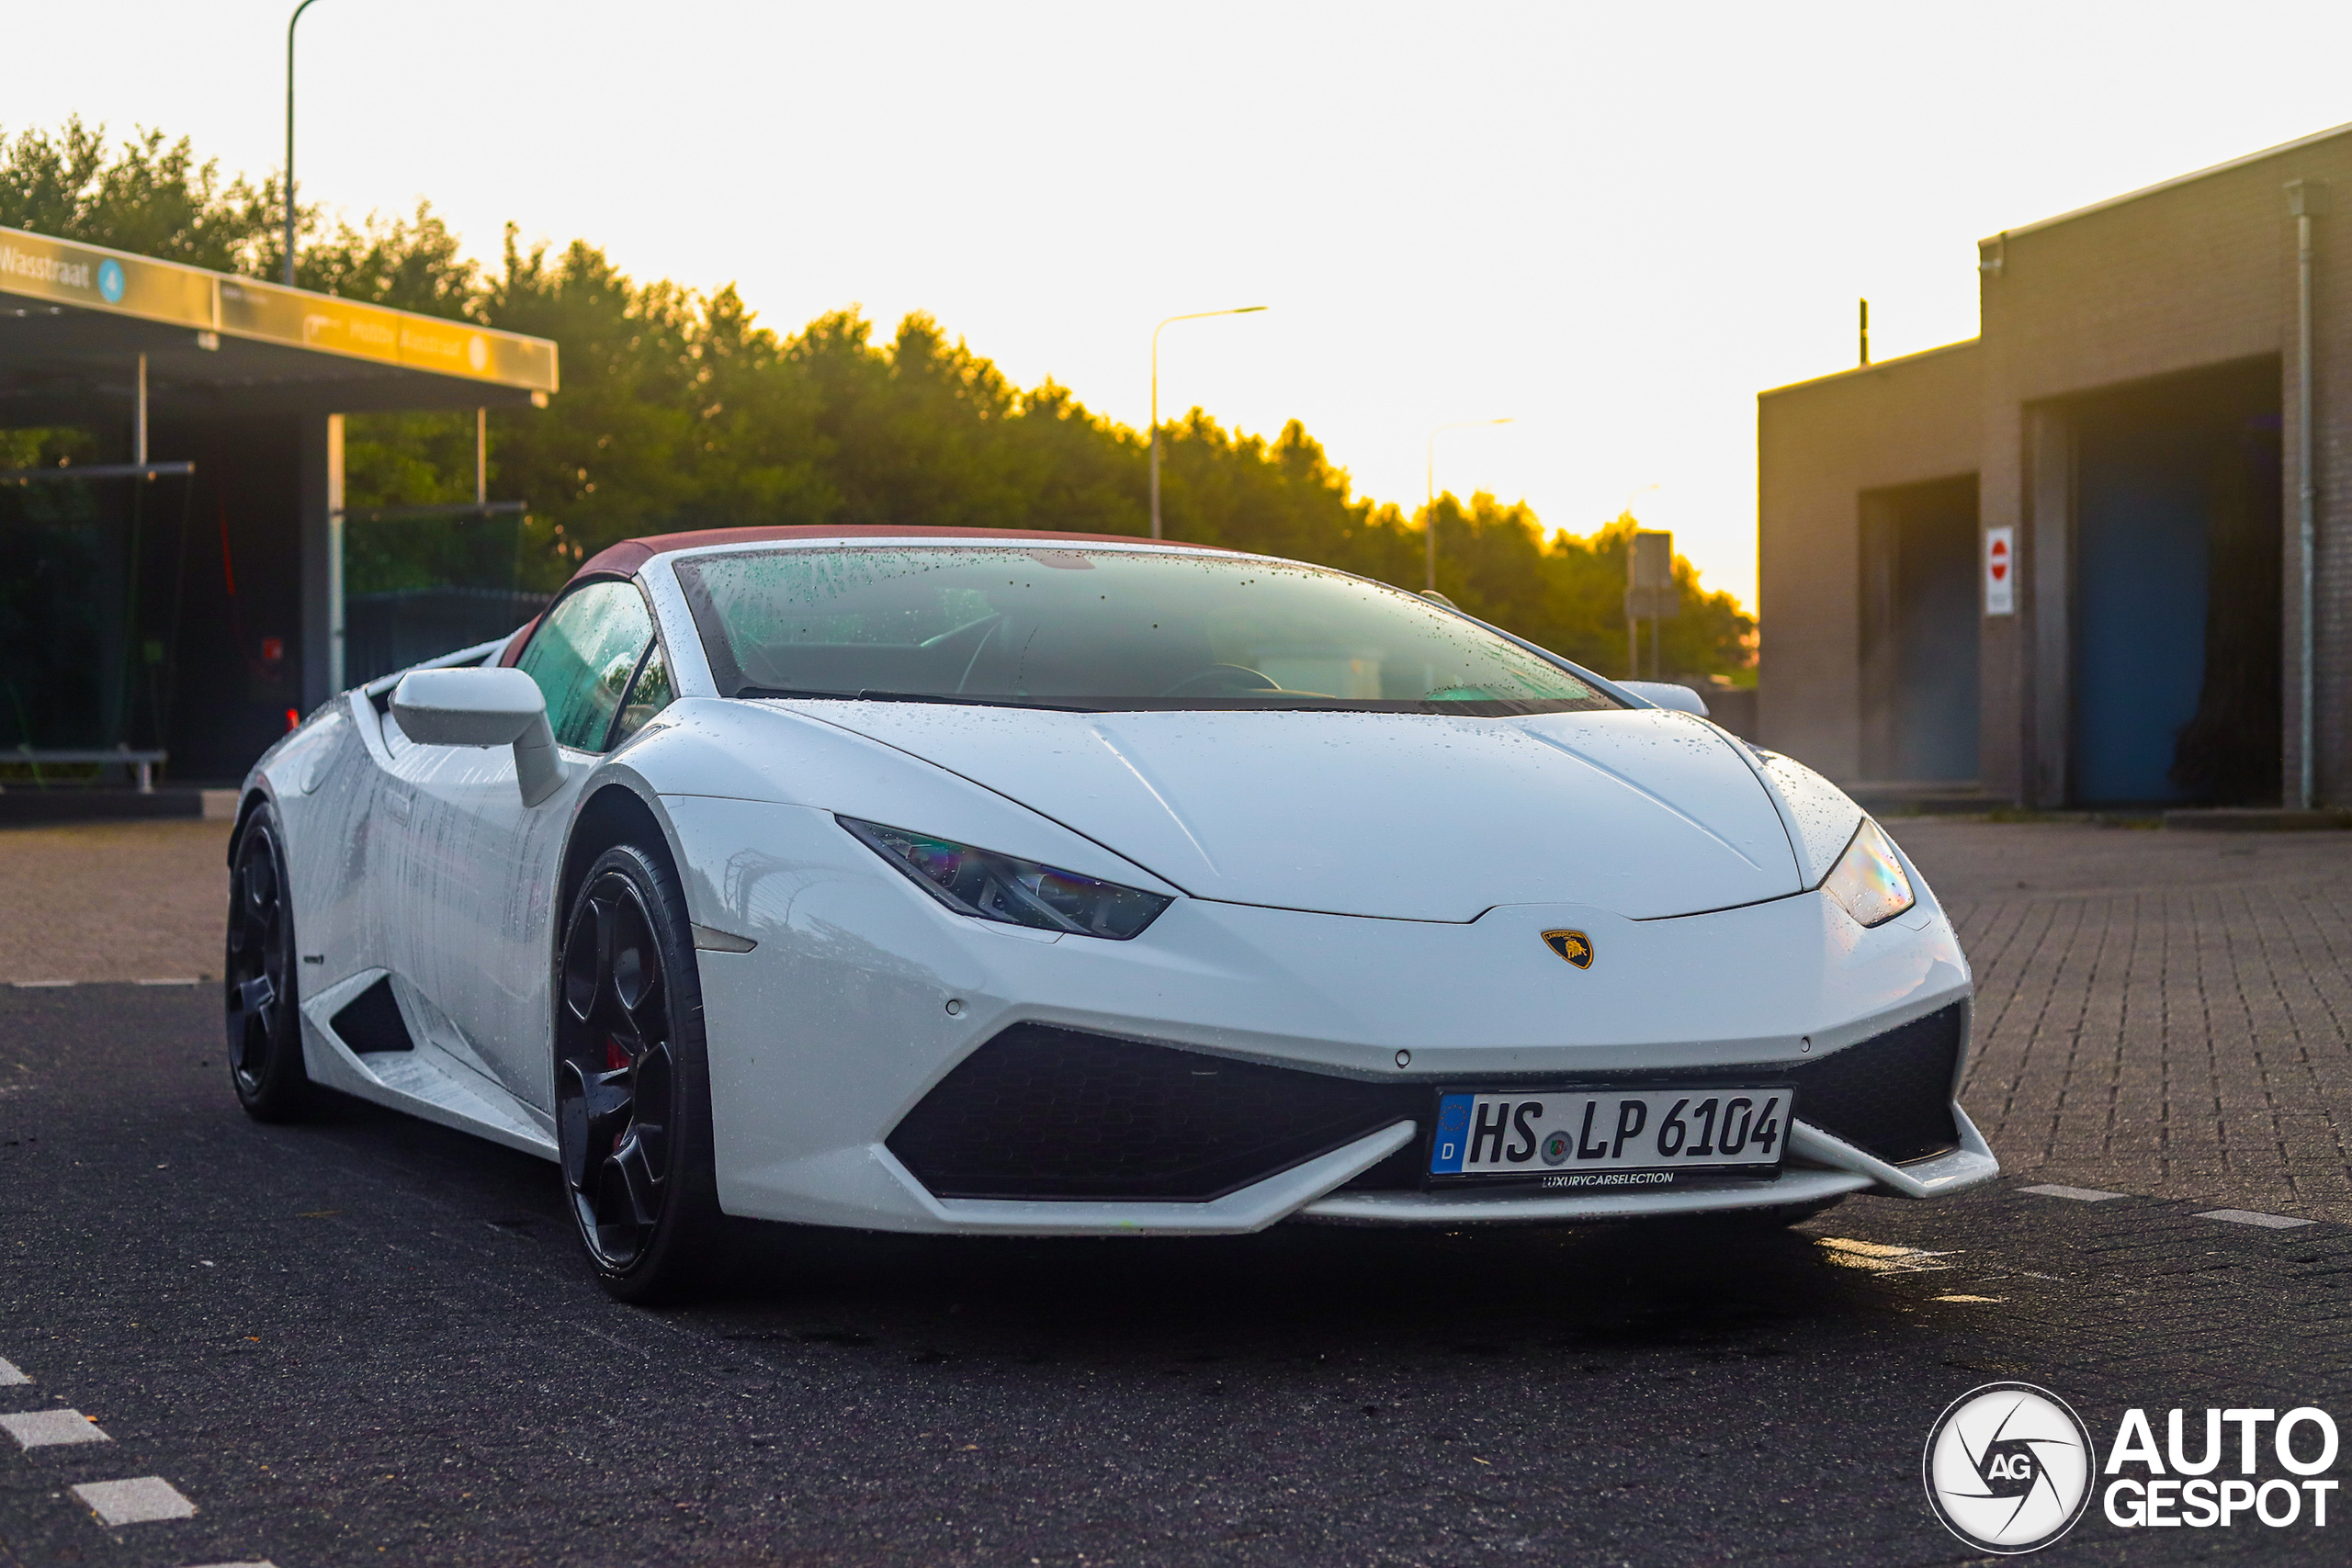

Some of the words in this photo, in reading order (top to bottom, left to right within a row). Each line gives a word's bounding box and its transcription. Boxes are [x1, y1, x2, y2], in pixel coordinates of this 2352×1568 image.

[1442, 1143, 1454, 1160] D
[1470, 1100, 1544, 1163] HS
[1577, 1100, 1647, 1159] LP
[1657, 1097, 1779, 1157] 6104
